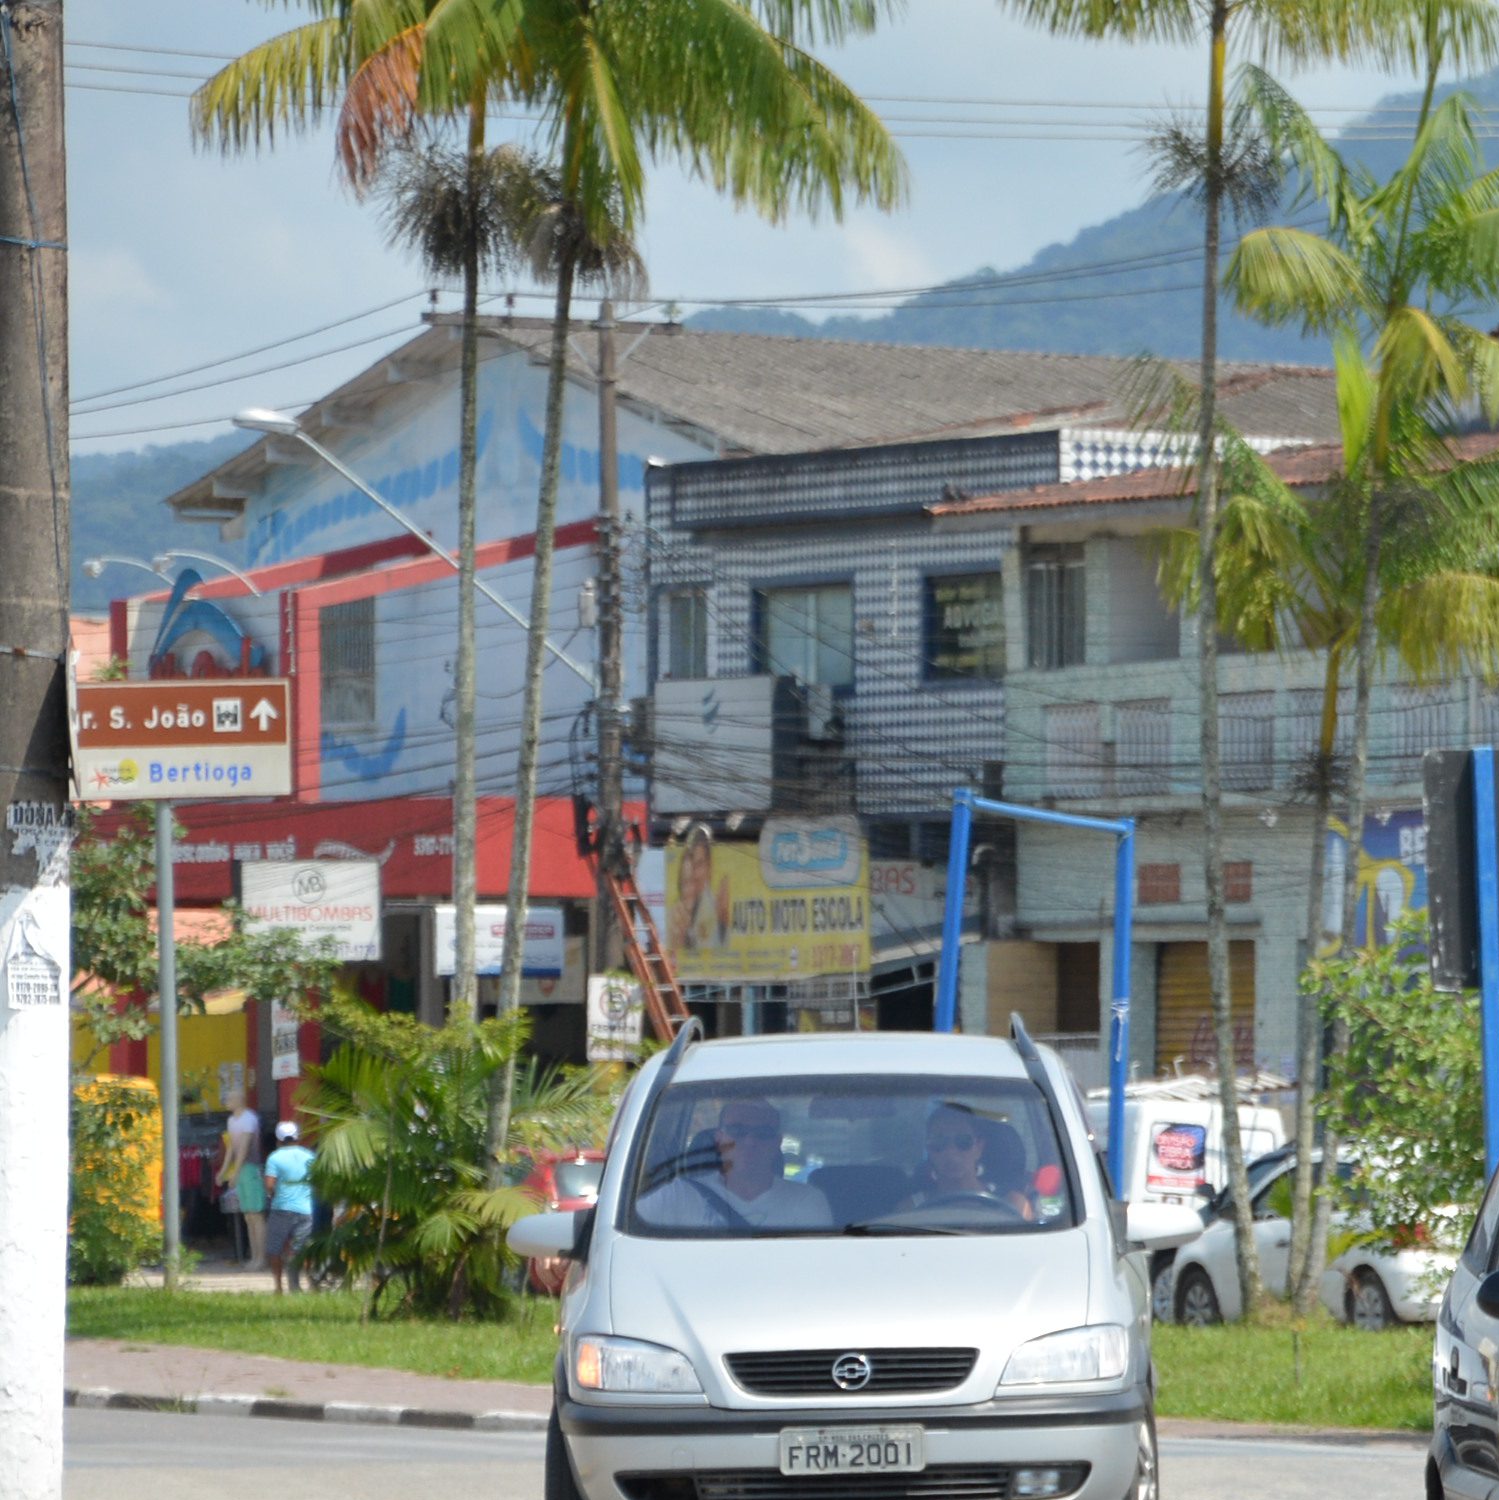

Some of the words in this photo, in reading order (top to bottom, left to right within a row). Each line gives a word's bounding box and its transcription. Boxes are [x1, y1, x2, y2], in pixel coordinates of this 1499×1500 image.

[109, 706, 132, 729] S.
[144, 704, 206, 730] João
[150, 763, 253, 787] Bertioga
[248, 905, 374, 922] MULTIBOMBAS
[733, 900, 767, 934] AUTO
[771, 898, 809, 934] MOTO
[812, 896, 866, 932] ESCOLA
